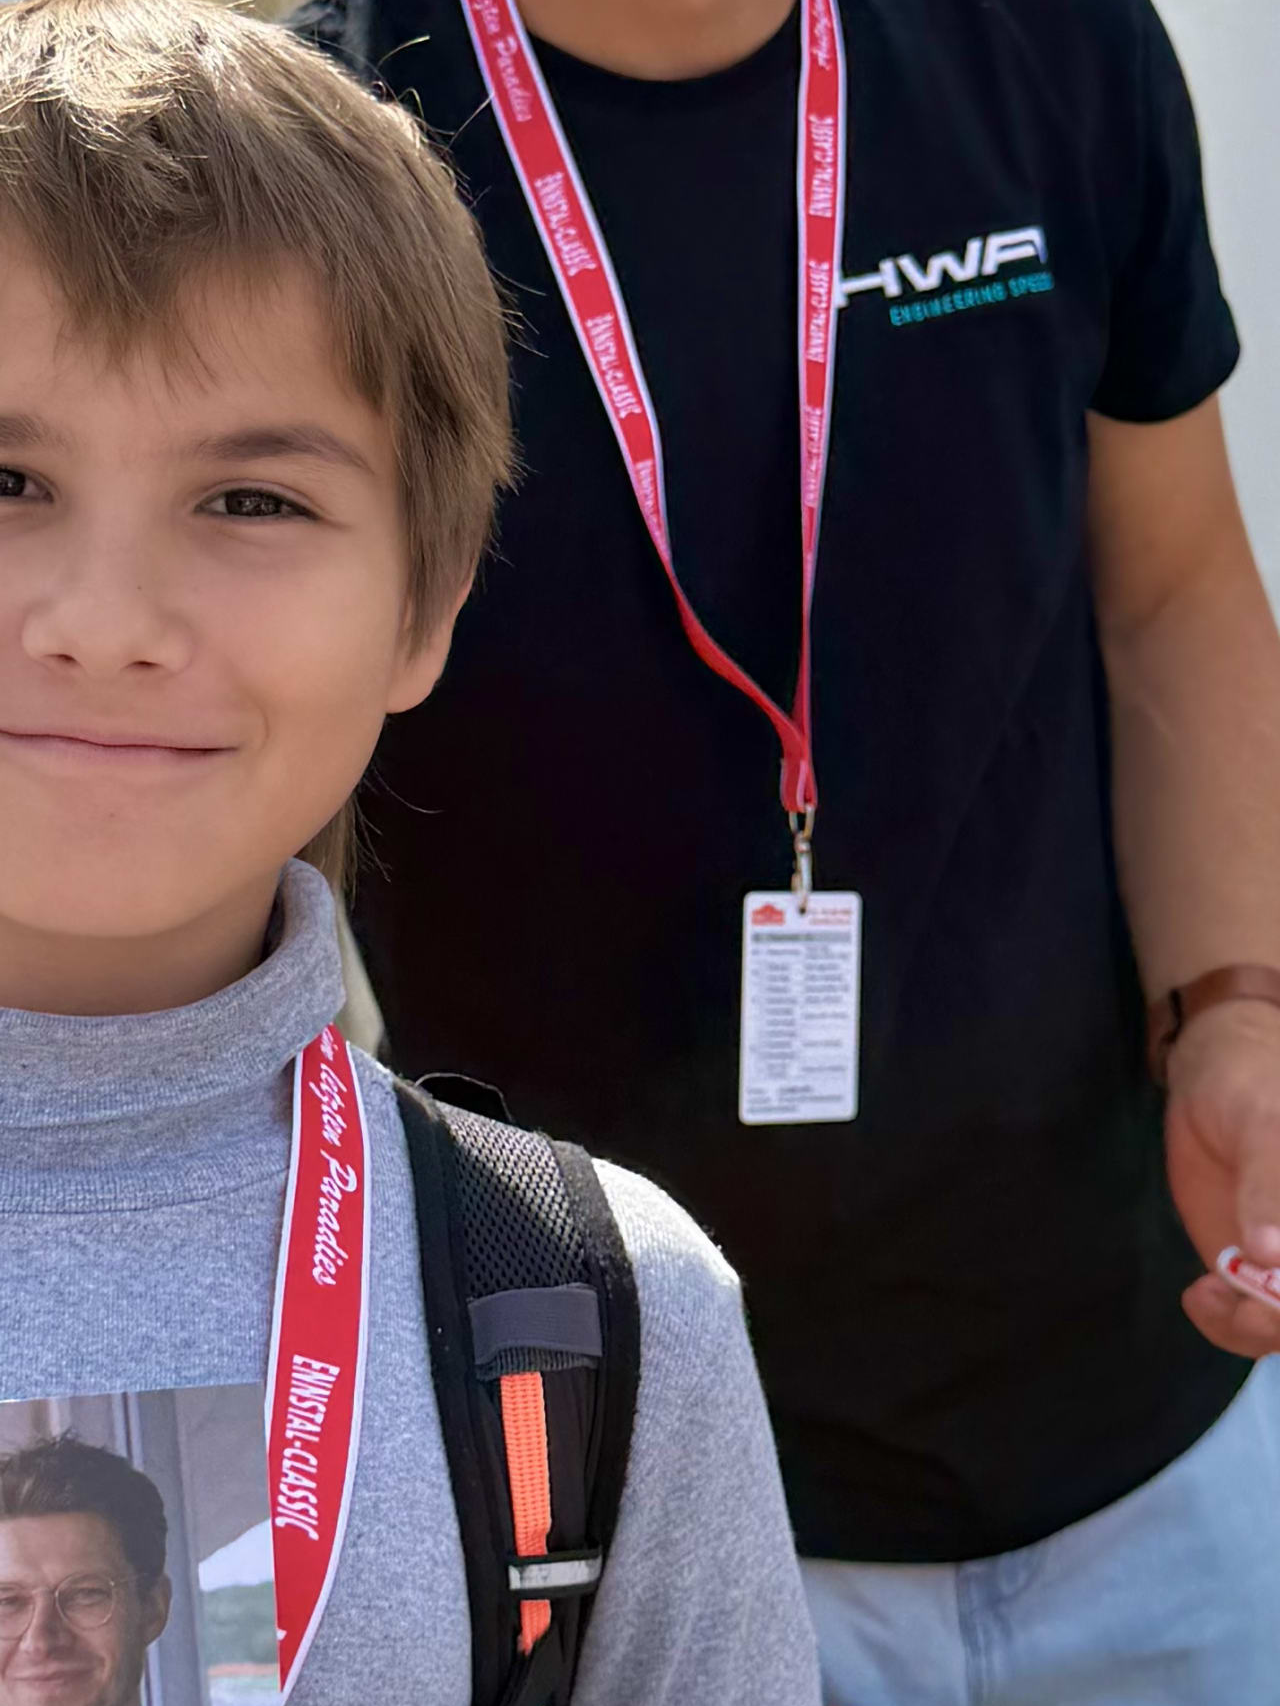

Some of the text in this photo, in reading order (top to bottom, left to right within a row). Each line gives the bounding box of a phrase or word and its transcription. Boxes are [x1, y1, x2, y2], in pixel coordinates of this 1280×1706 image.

[495, 35, 533, 123] Paradies
[808, 115, 835, 218] ENNSTAL-CLASSIC
[533, 172, 597, 277] ENNSTAL-CLASSIC
[837, 225, 1048, 309] HWA
[807, 260, 830, 363] ENNSTAL-CLASSIC
[889, 280, 1007, 327] ENGINEERING
[585, 313, 642, 419] ENNSTAL-CLASSIC
[308, 1062, 348, 1147] letzten
[311, 1149, 358, 1286] Paradies
[274, 1353, 341, 1542] ENNSTAL-CLASSIC
